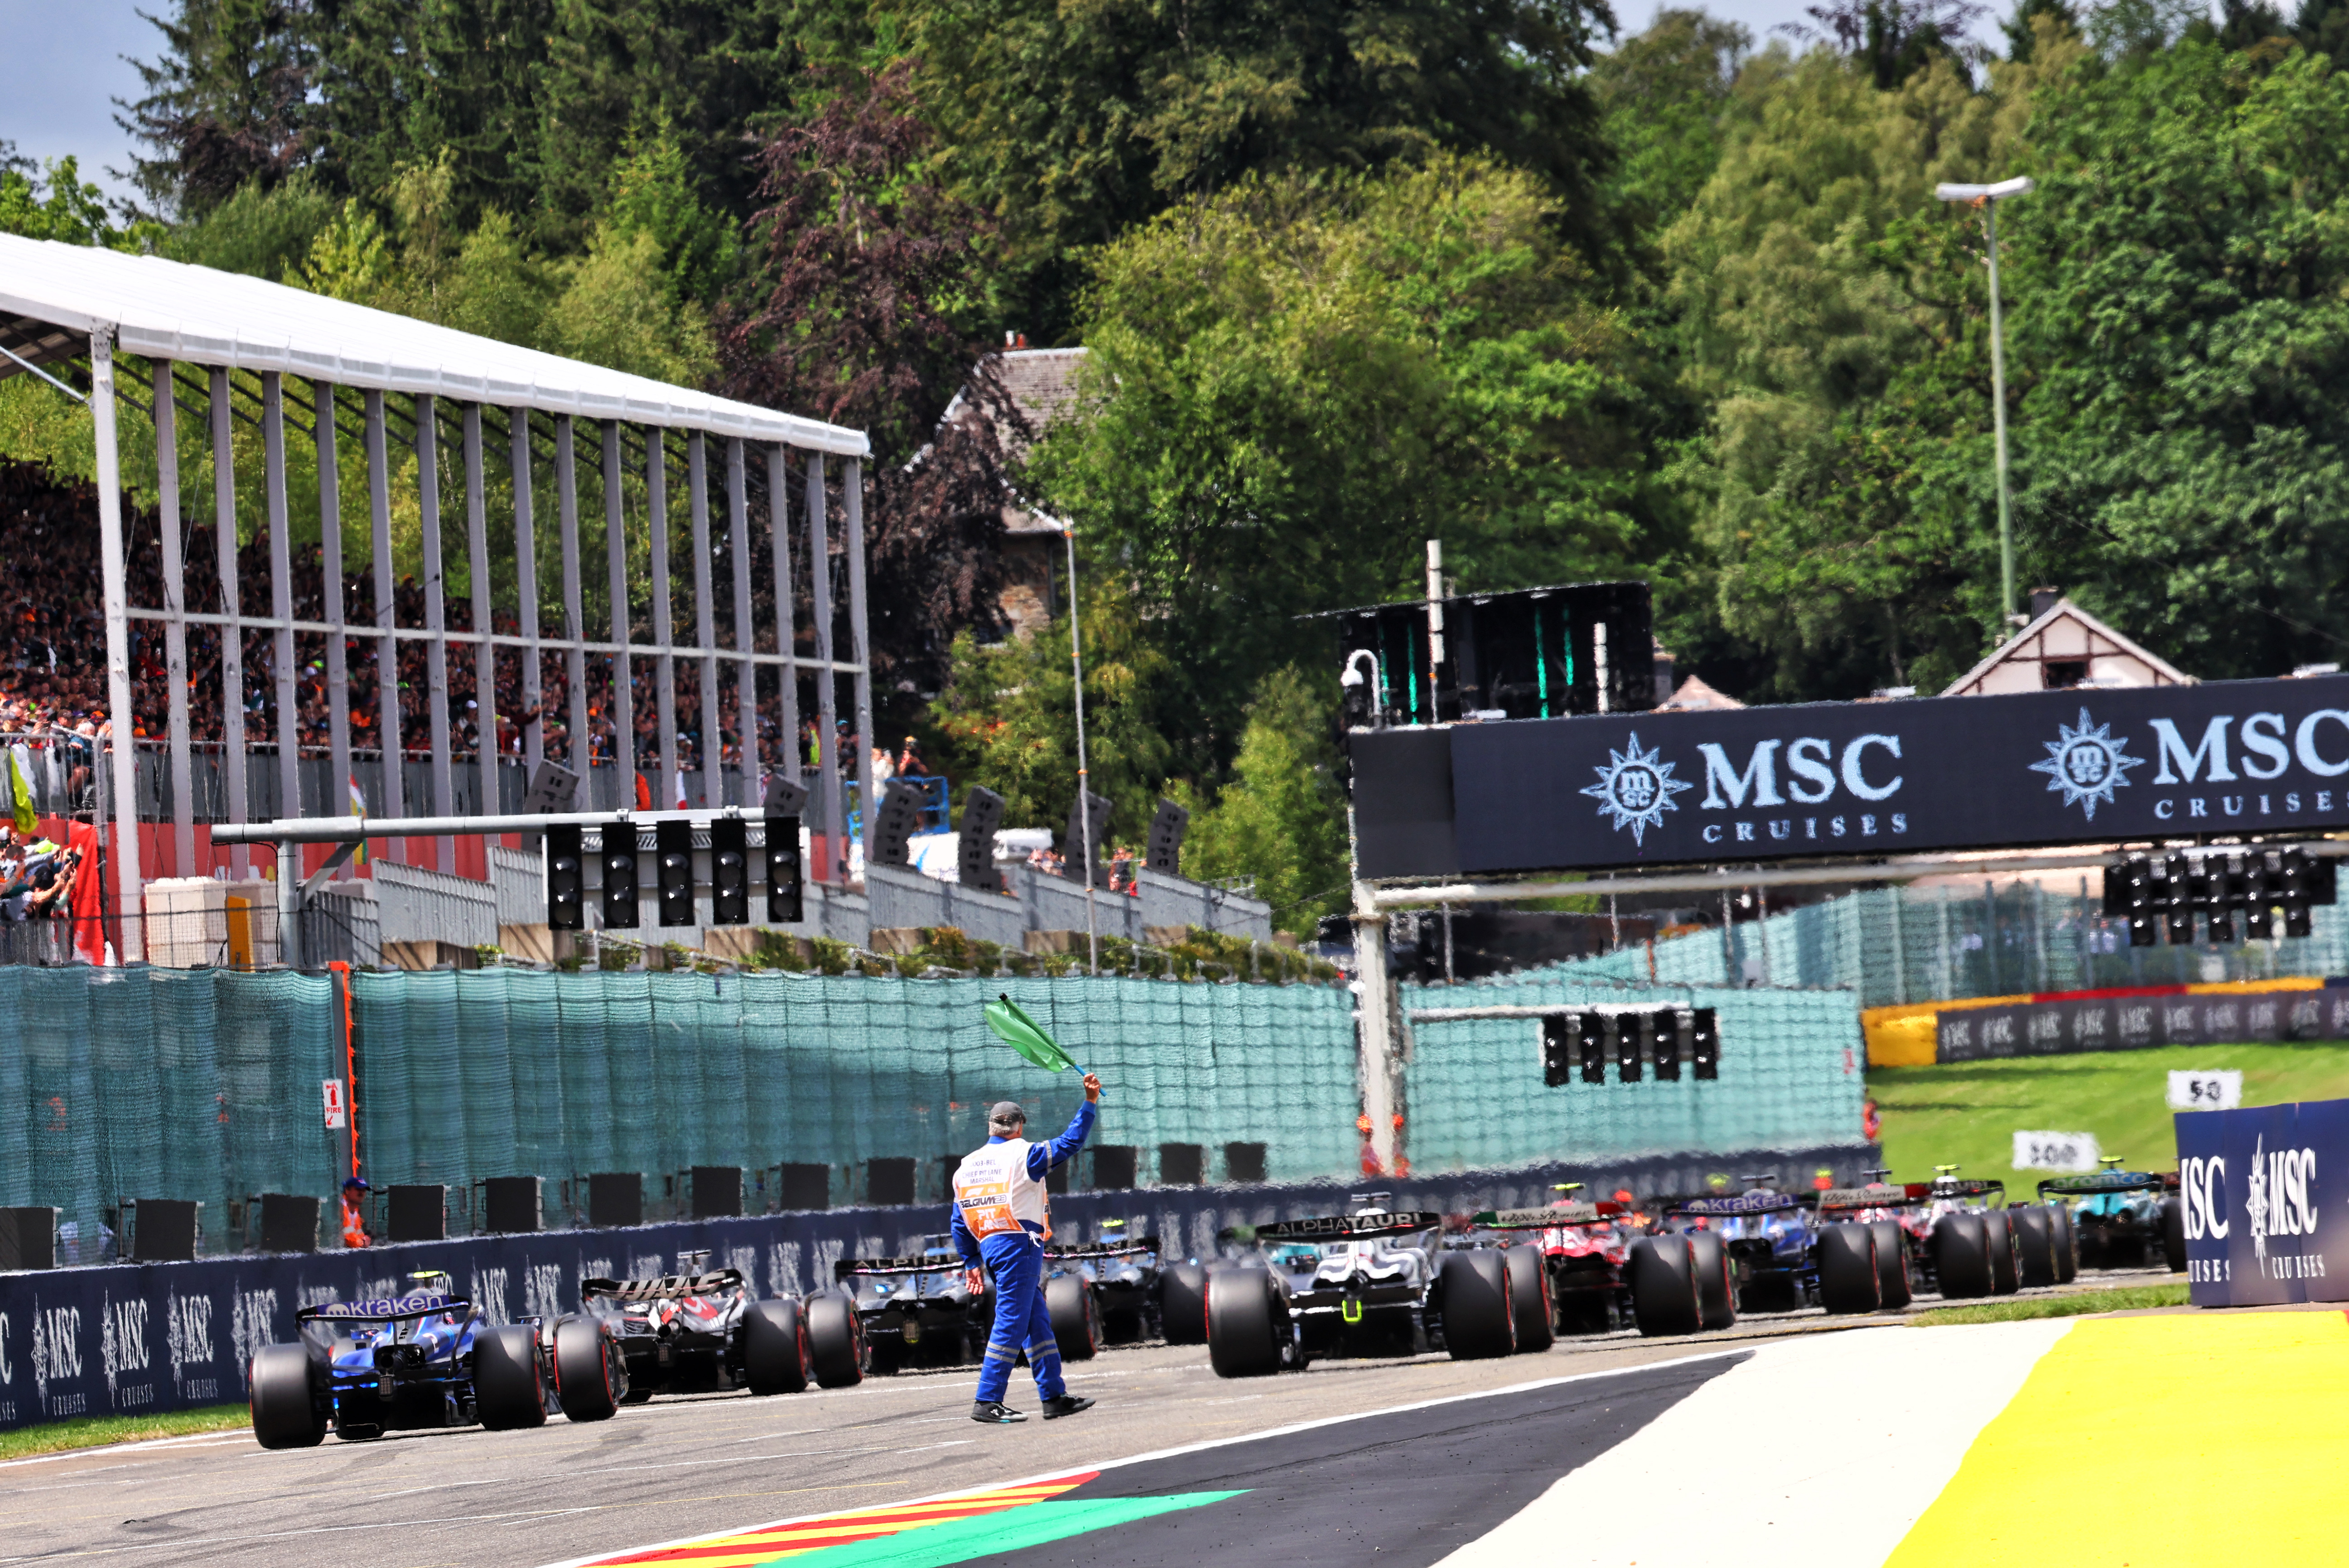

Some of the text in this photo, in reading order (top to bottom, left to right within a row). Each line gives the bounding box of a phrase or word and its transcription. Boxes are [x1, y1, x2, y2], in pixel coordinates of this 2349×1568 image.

[2147, 709, 2349, 784] MSC
[1696, 733, 1903, 809] MSC
[2154, 790, 2349, 819] CRUISE
[1703, 813, 1907, 843] CRUISES
[2190, 1080, 2221, 1102] 50
[2053, 1174, 2148, 1189] aramco
[2269, 1147, 2317, 1235] MSC
[976, 1208, 996, 1220] PIT
[1710, 1193, 1793, 1211] kraken
[1277, 1213, 1422, 1235] ALPHATAURI
[2272, 1254, 2325, 1279] CRUISES
[350, 1295, 443, 1316] kraken
[46, 1306, 82, 1380] MSC
[116, 1298, 150, 1371] MSC
[181, 1294, 214, 1363] MSC
